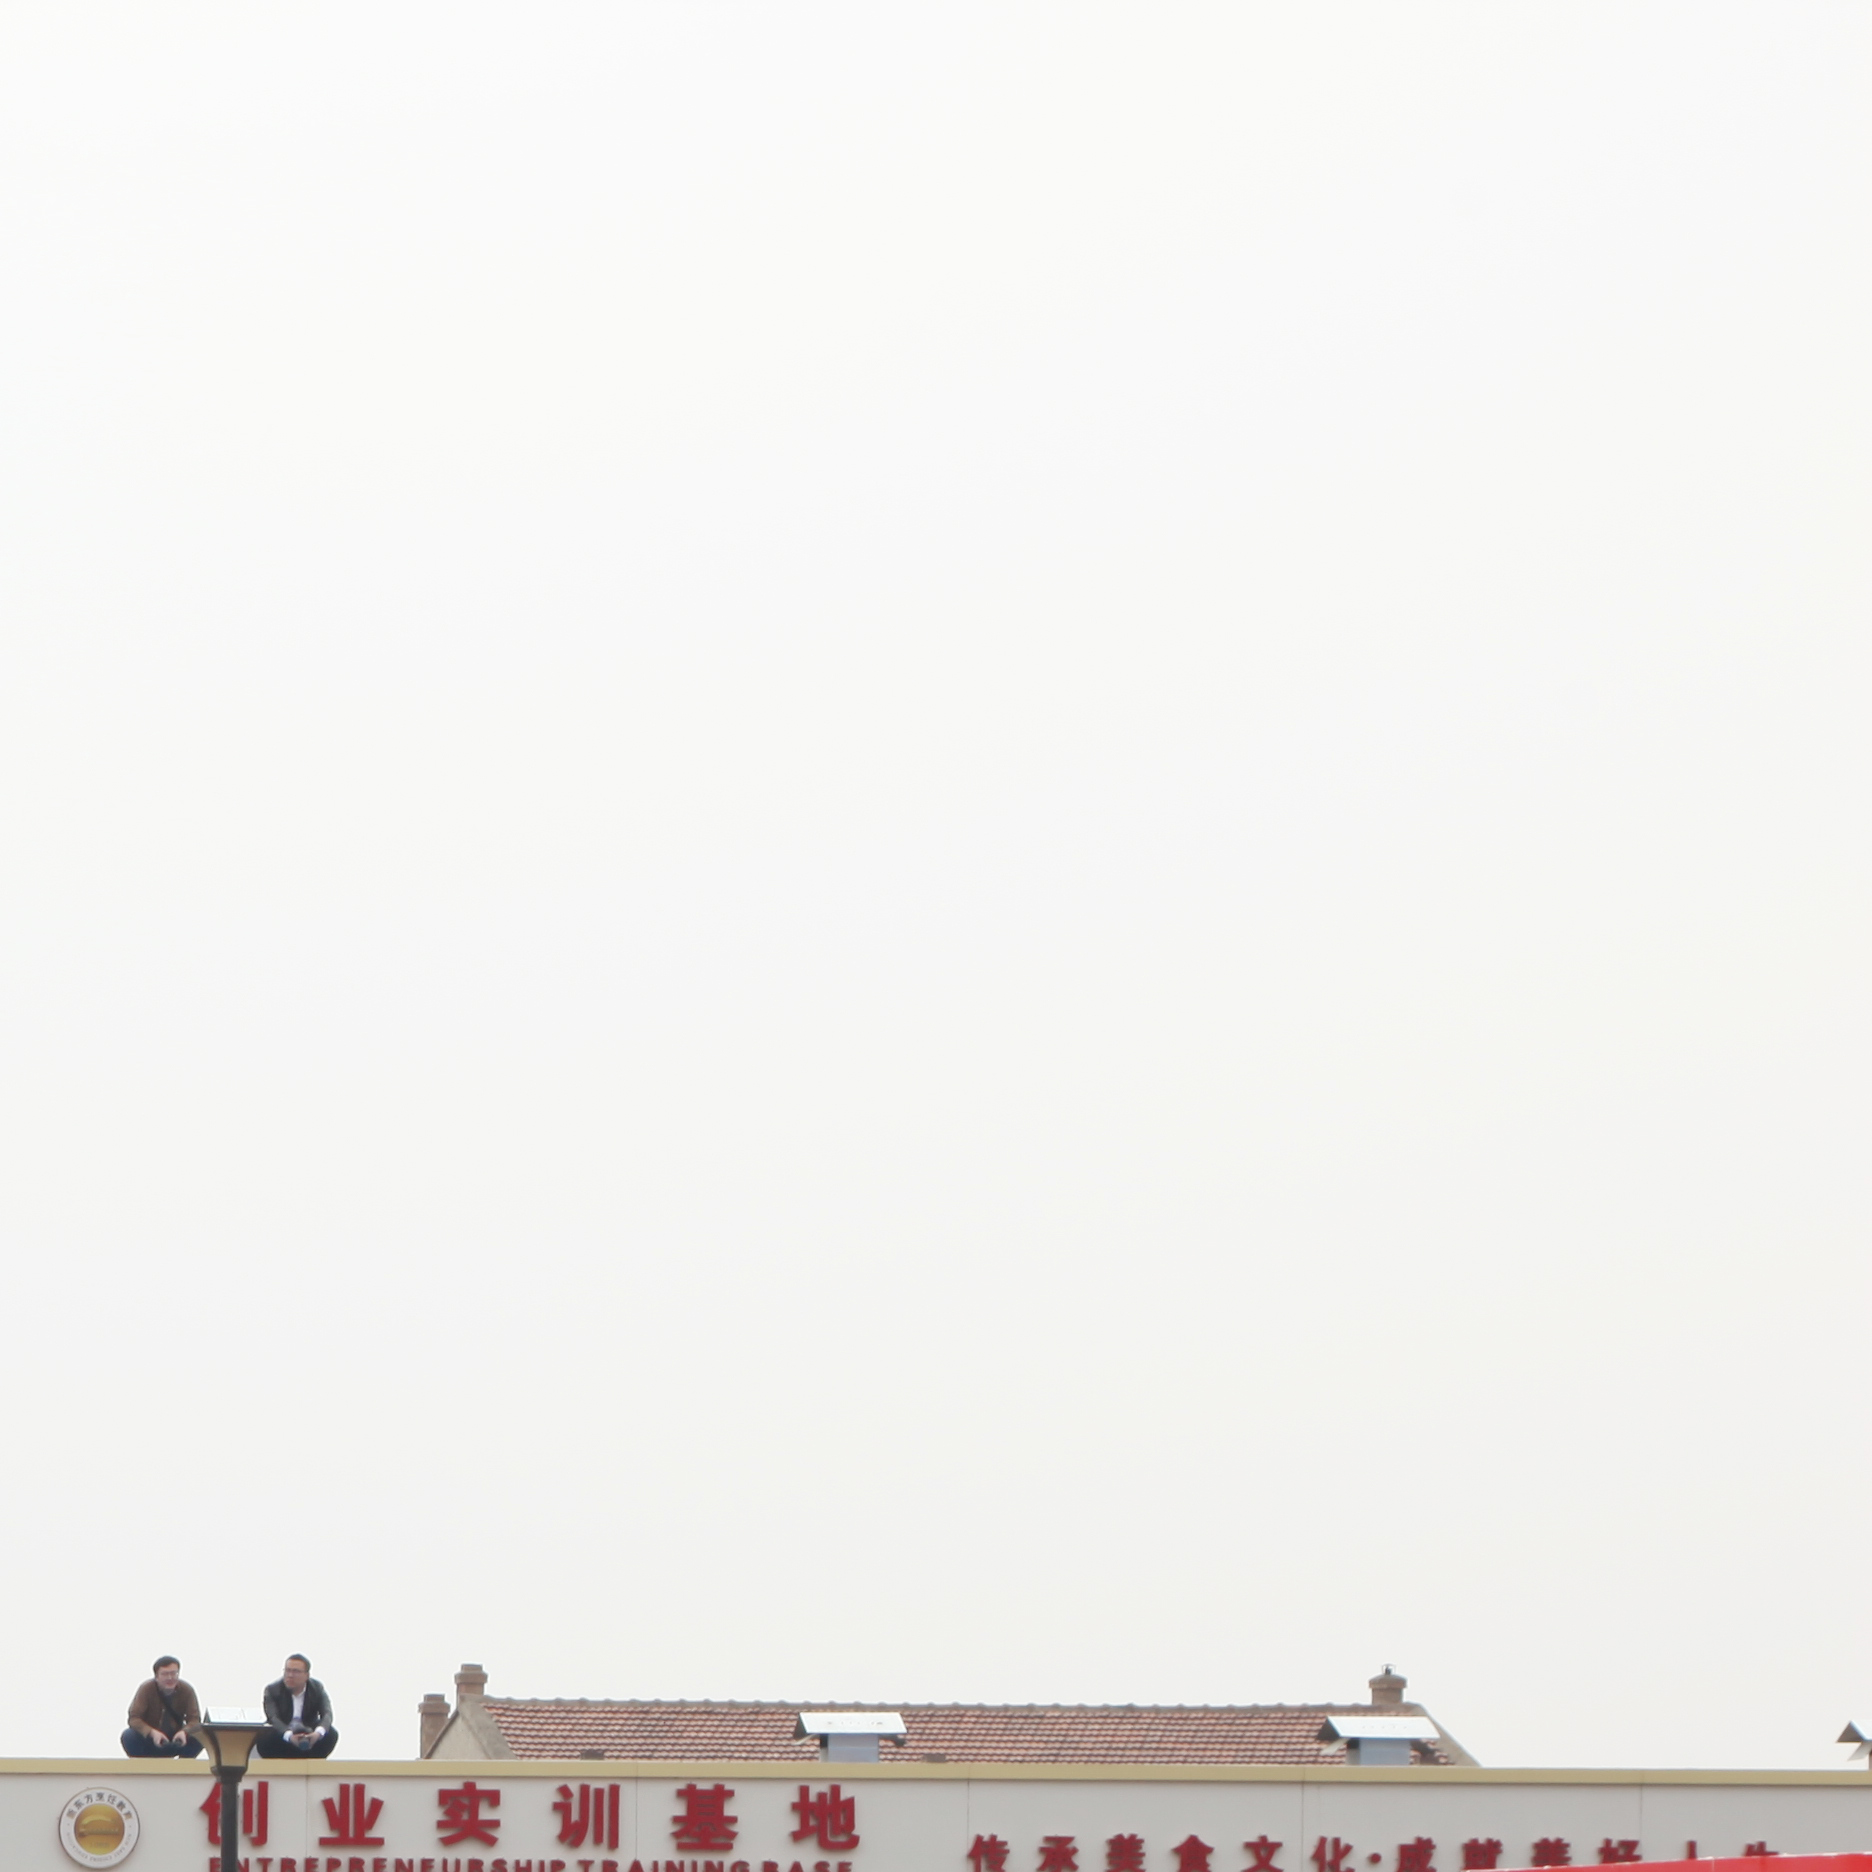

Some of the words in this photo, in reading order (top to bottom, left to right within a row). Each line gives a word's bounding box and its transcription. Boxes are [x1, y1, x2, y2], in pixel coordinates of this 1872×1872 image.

[200, 1781, 860, 1852] 创业实训基地
